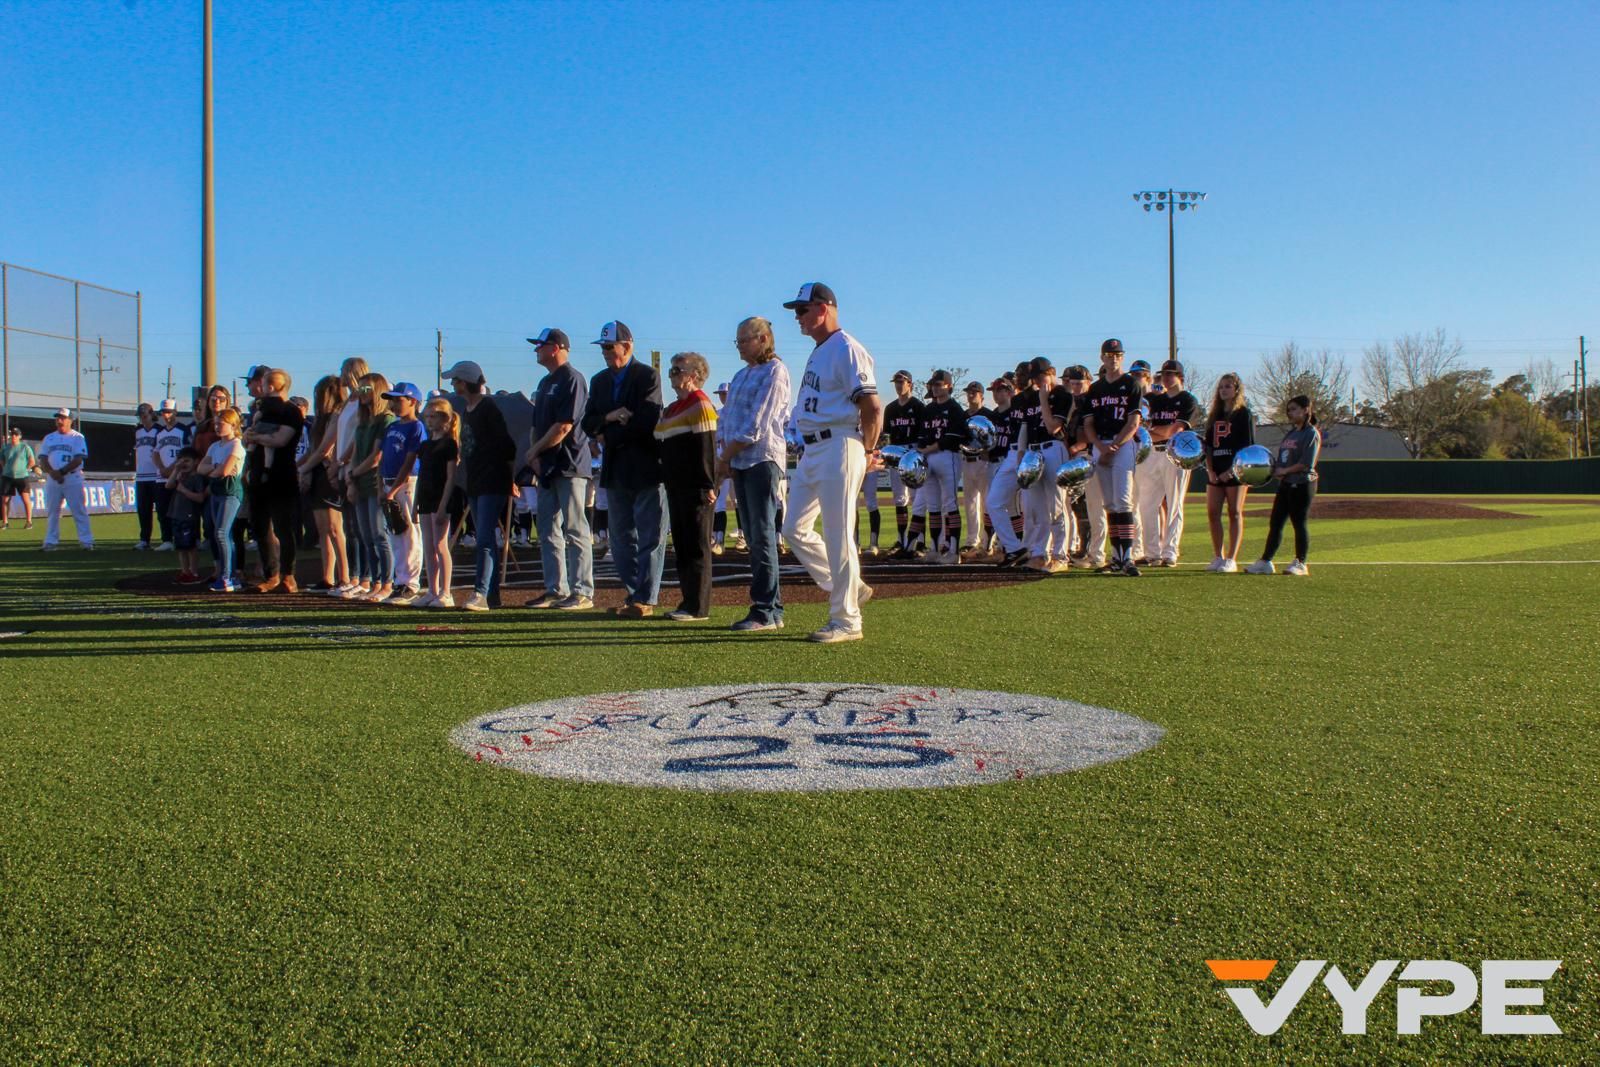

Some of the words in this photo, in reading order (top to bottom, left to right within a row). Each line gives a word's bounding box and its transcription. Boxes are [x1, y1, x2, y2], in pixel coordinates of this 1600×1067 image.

[804, 397, 819, 413] 27
[1120, 396, 1129, 406] X
[1113, 406, 1126, 420] 12
[934, 427, 942, 439] 3
[1213, 420, 1232, 448] P
[480, 707, 1051, 732] CRUSADERS
[663, 731, 955, 771] 25
